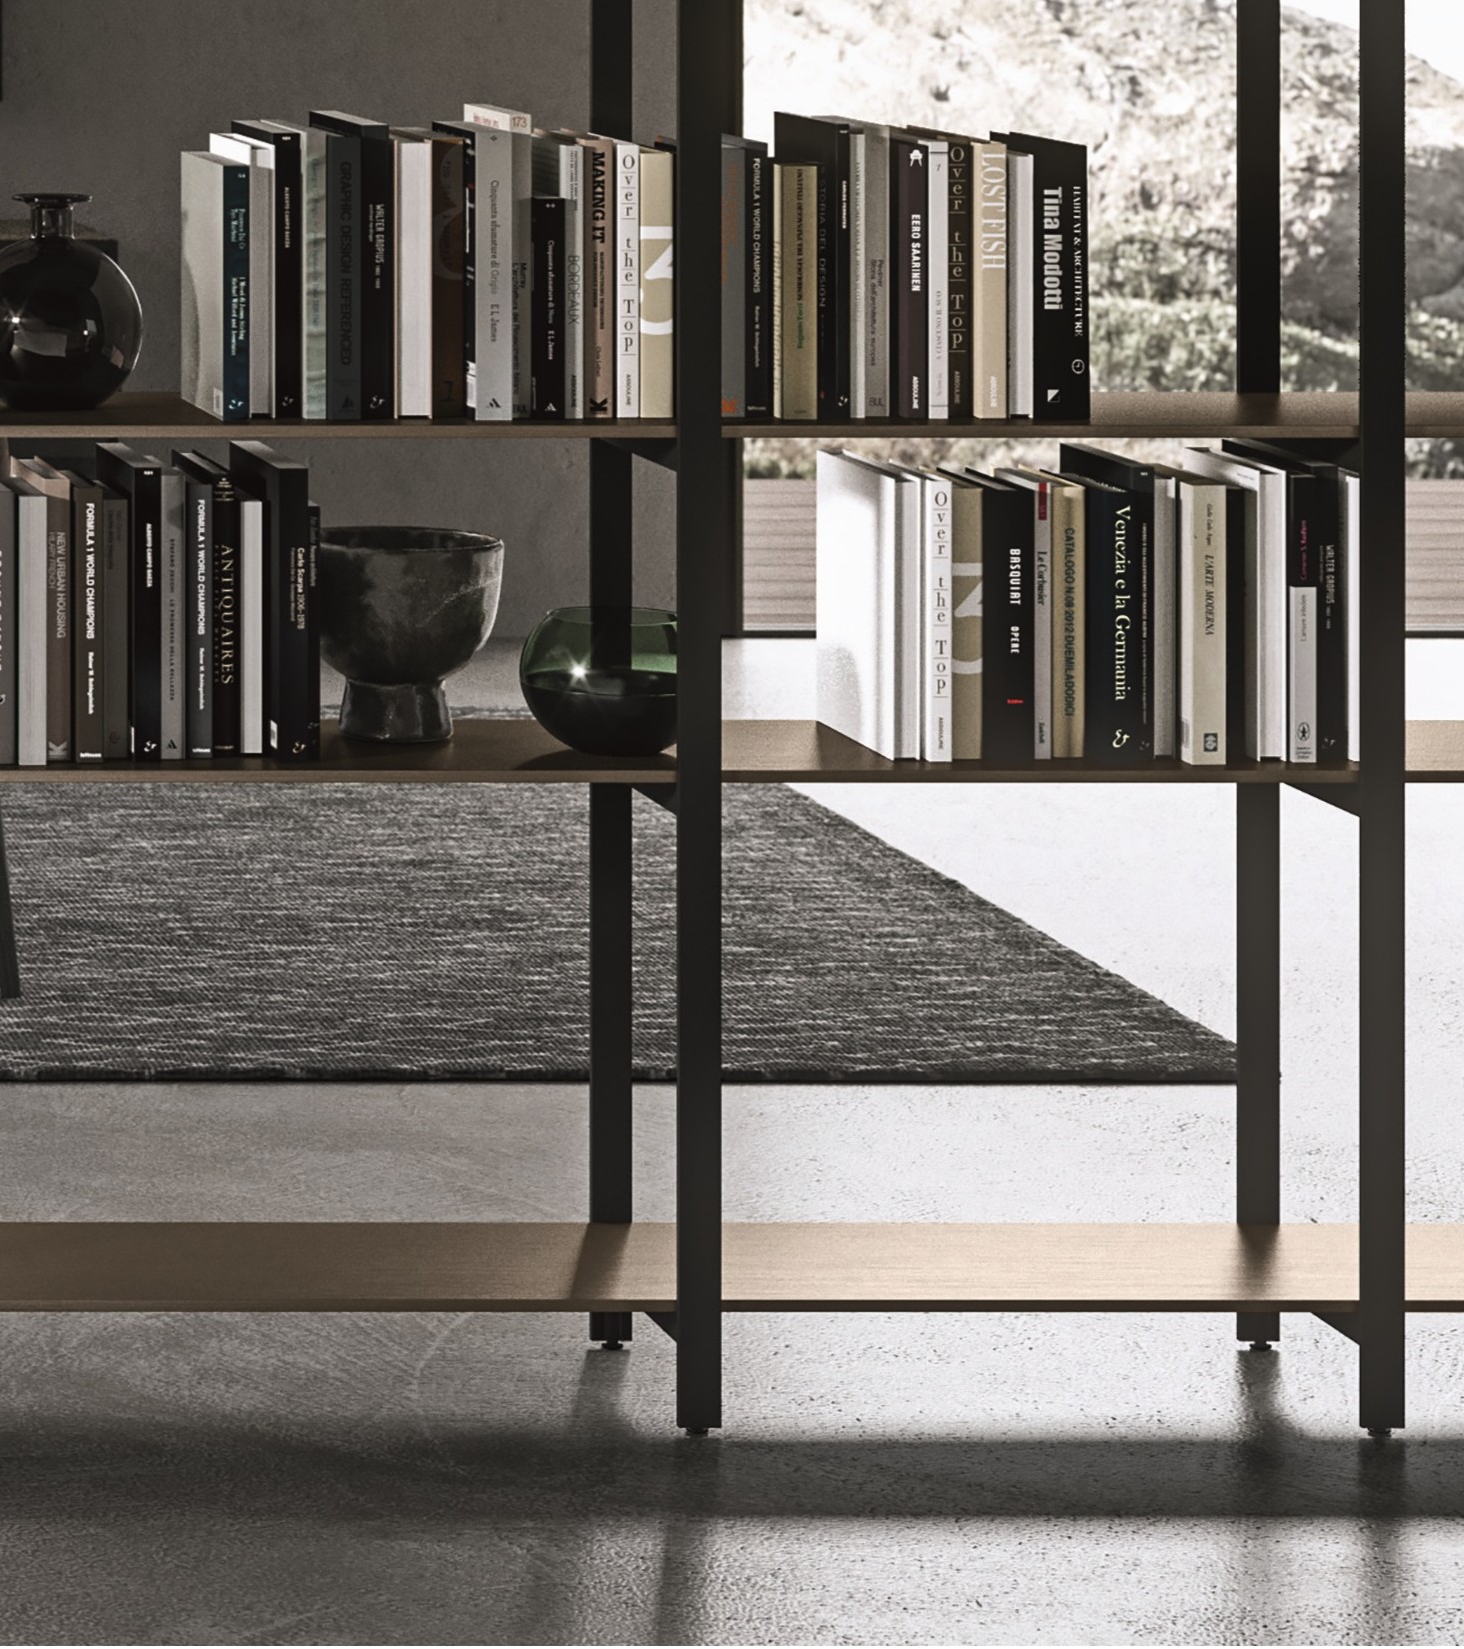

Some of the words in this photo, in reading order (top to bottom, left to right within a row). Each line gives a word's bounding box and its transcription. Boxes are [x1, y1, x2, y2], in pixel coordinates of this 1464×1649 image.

[592, 152, 605, 222] MAKING
[1043, 187, 1063, 229] Tina
[592, 226, 605, 243] IT
[1043, 234, 1063, 310] Modotti
[1037, 551, 1046, 563] Le
[1114, 505, 1131, 574] Venezia
[1008, 548, 1021, 605] BASQUIAT
[1037, 565, 1046, 605] Corbusier
[1114, 579, 1129, 589] e
[1205, 555, 1214, 587] L'ARTE
[1114, 594, 1131, 609] la
[1205, 590, 1214, 635] MODERNA
[1010, 626, 1020, 654] OPERE
[1114, 614, 1131, 701] Germania
